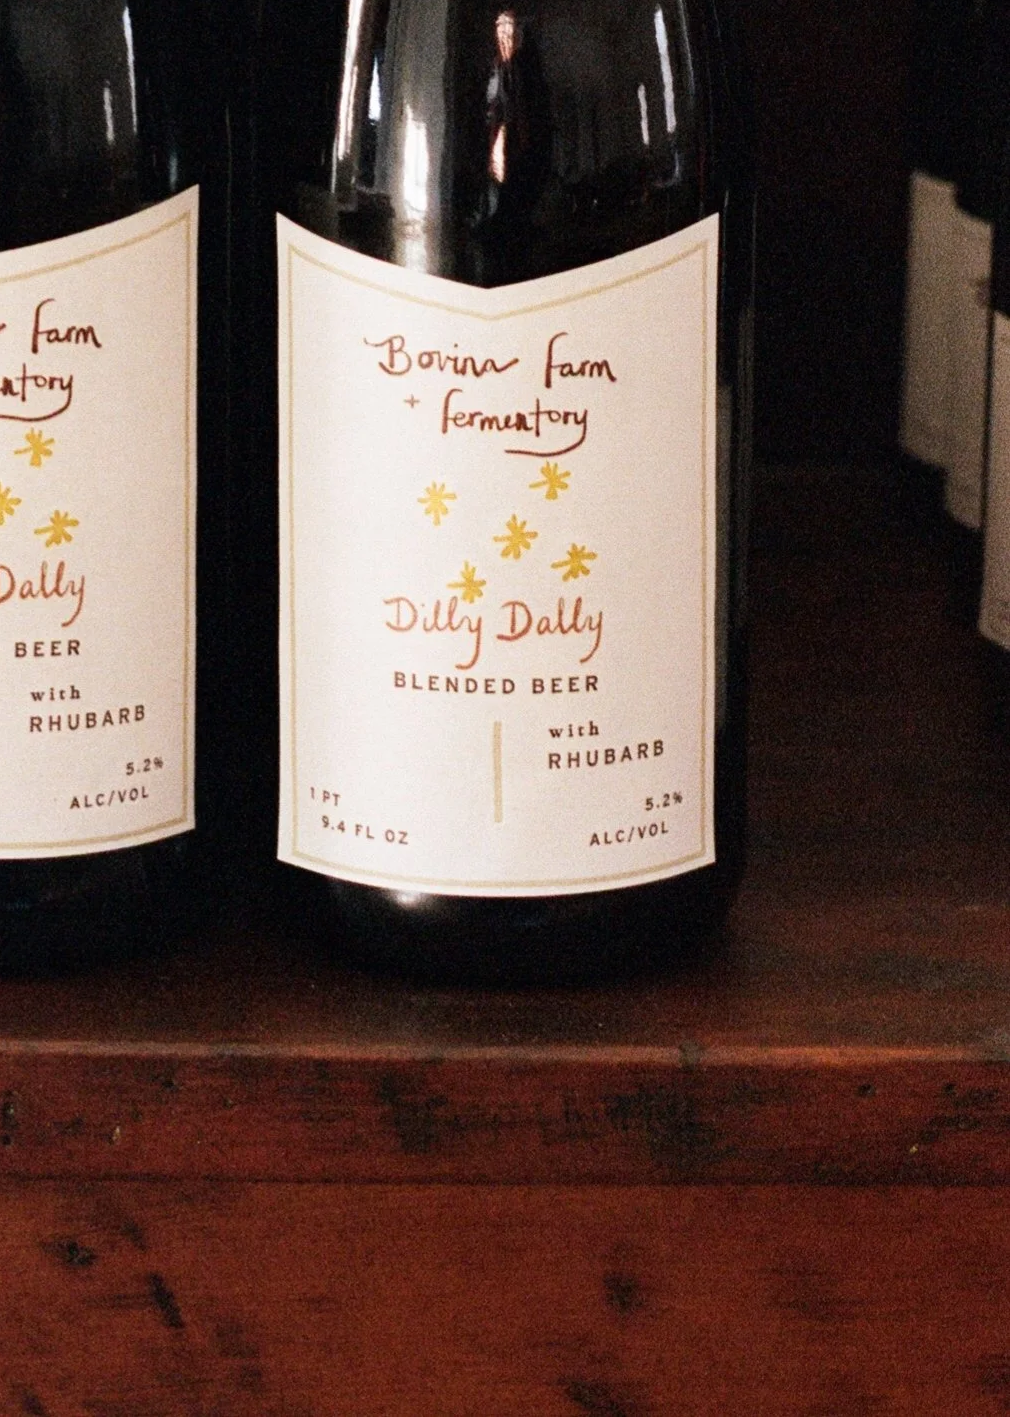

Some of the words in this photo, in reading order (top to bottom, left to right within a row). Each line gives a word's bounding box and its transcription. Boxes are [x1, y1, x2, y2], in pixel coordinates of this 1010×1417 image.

[383, 595, 484, 670] Dilly
[495, 596, 603, 665] Dally
[14, 639, 81, 659] BEER
[30, 684, 81, 702] with
[393, 671, 516, 695] BLENDED
[531, 674, 599, 695] BEER
[29, 704, 145, 733] RHUBARB
[548, 720, 600, 739] with
[547, 737, 664, 770] RHUBARB
[126, 757, 163, 776] 5.2%
[69, 786, 148, 810] ALC/VOL
[322, 790, 340, 806] PT
[645, 792, 683, 812] 5.2%
[321, 814, 346, 833] 9.4
[354, 823, 374, 840] FL
[384, 829, 408, 845] OZ
[589, 821, 668, 846] ALC/VOL
